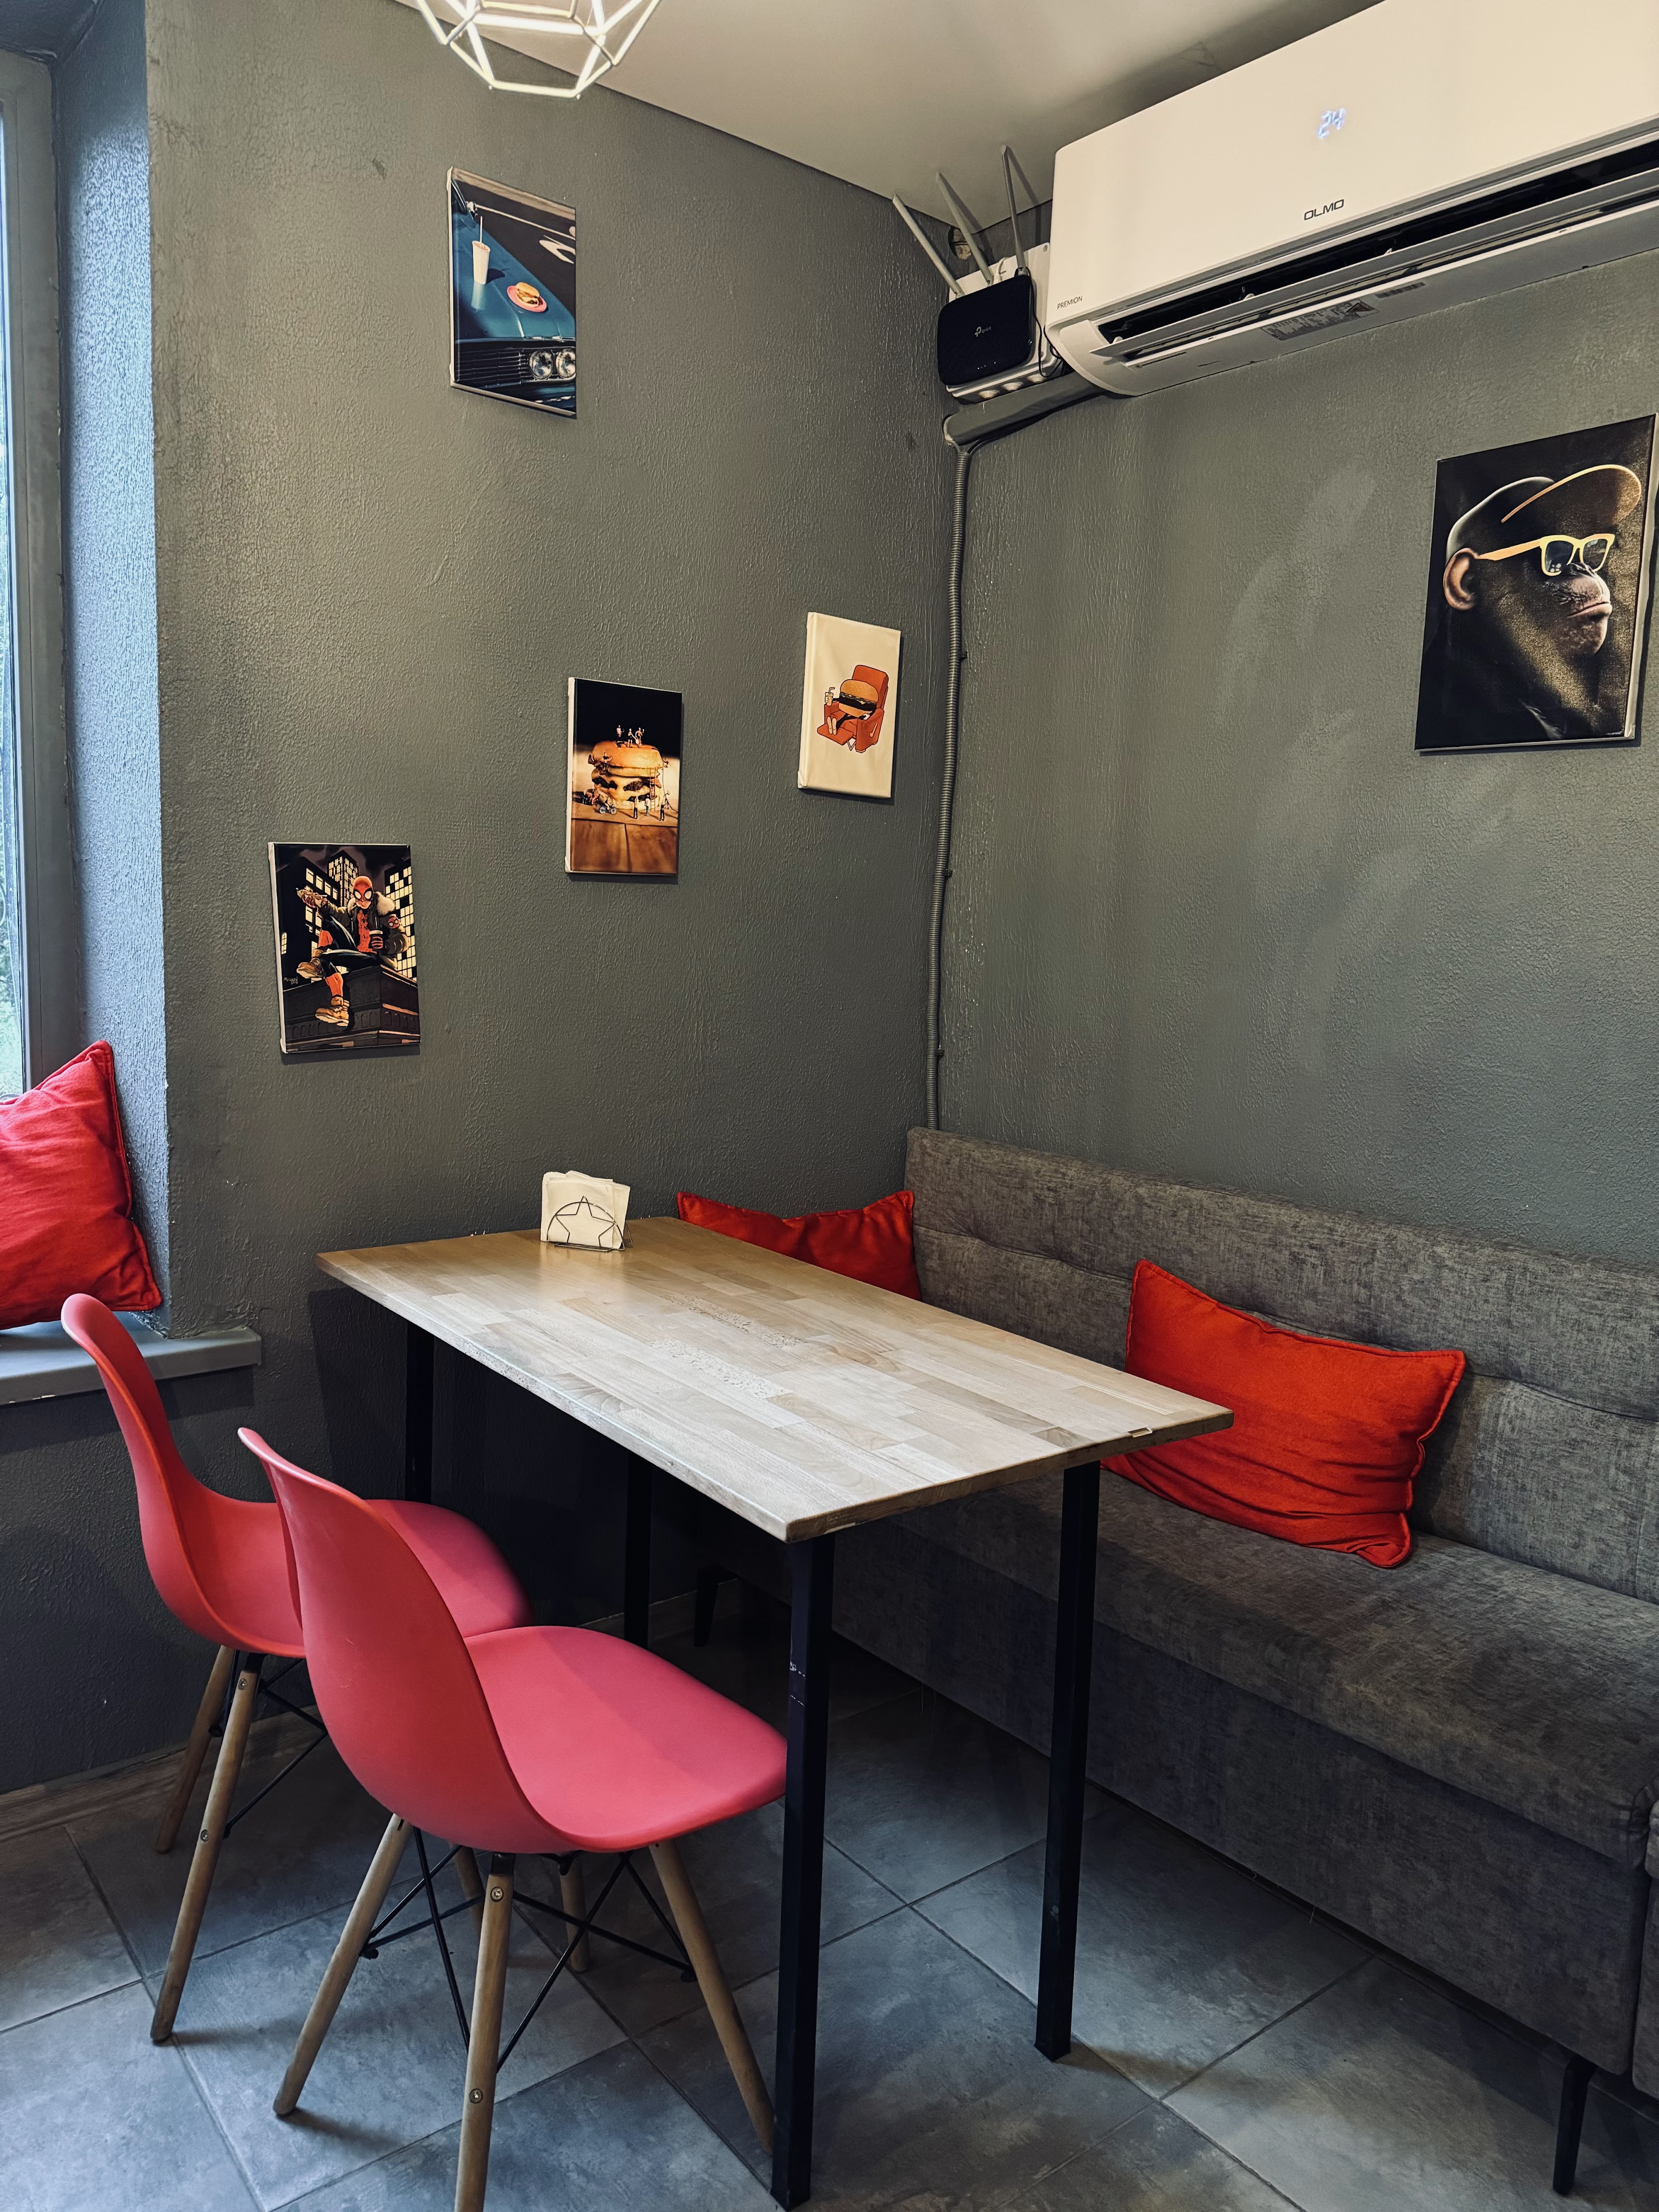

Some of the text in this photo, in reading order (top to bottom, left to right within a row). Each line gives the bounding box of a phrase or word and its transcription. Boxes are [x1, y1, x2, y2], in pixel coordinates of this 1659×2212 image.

[1317, 108, 1346, 139] 24
[1304, 199, 1344, 220] OLMO
[1057, 295, 1082, 310] PREMION
